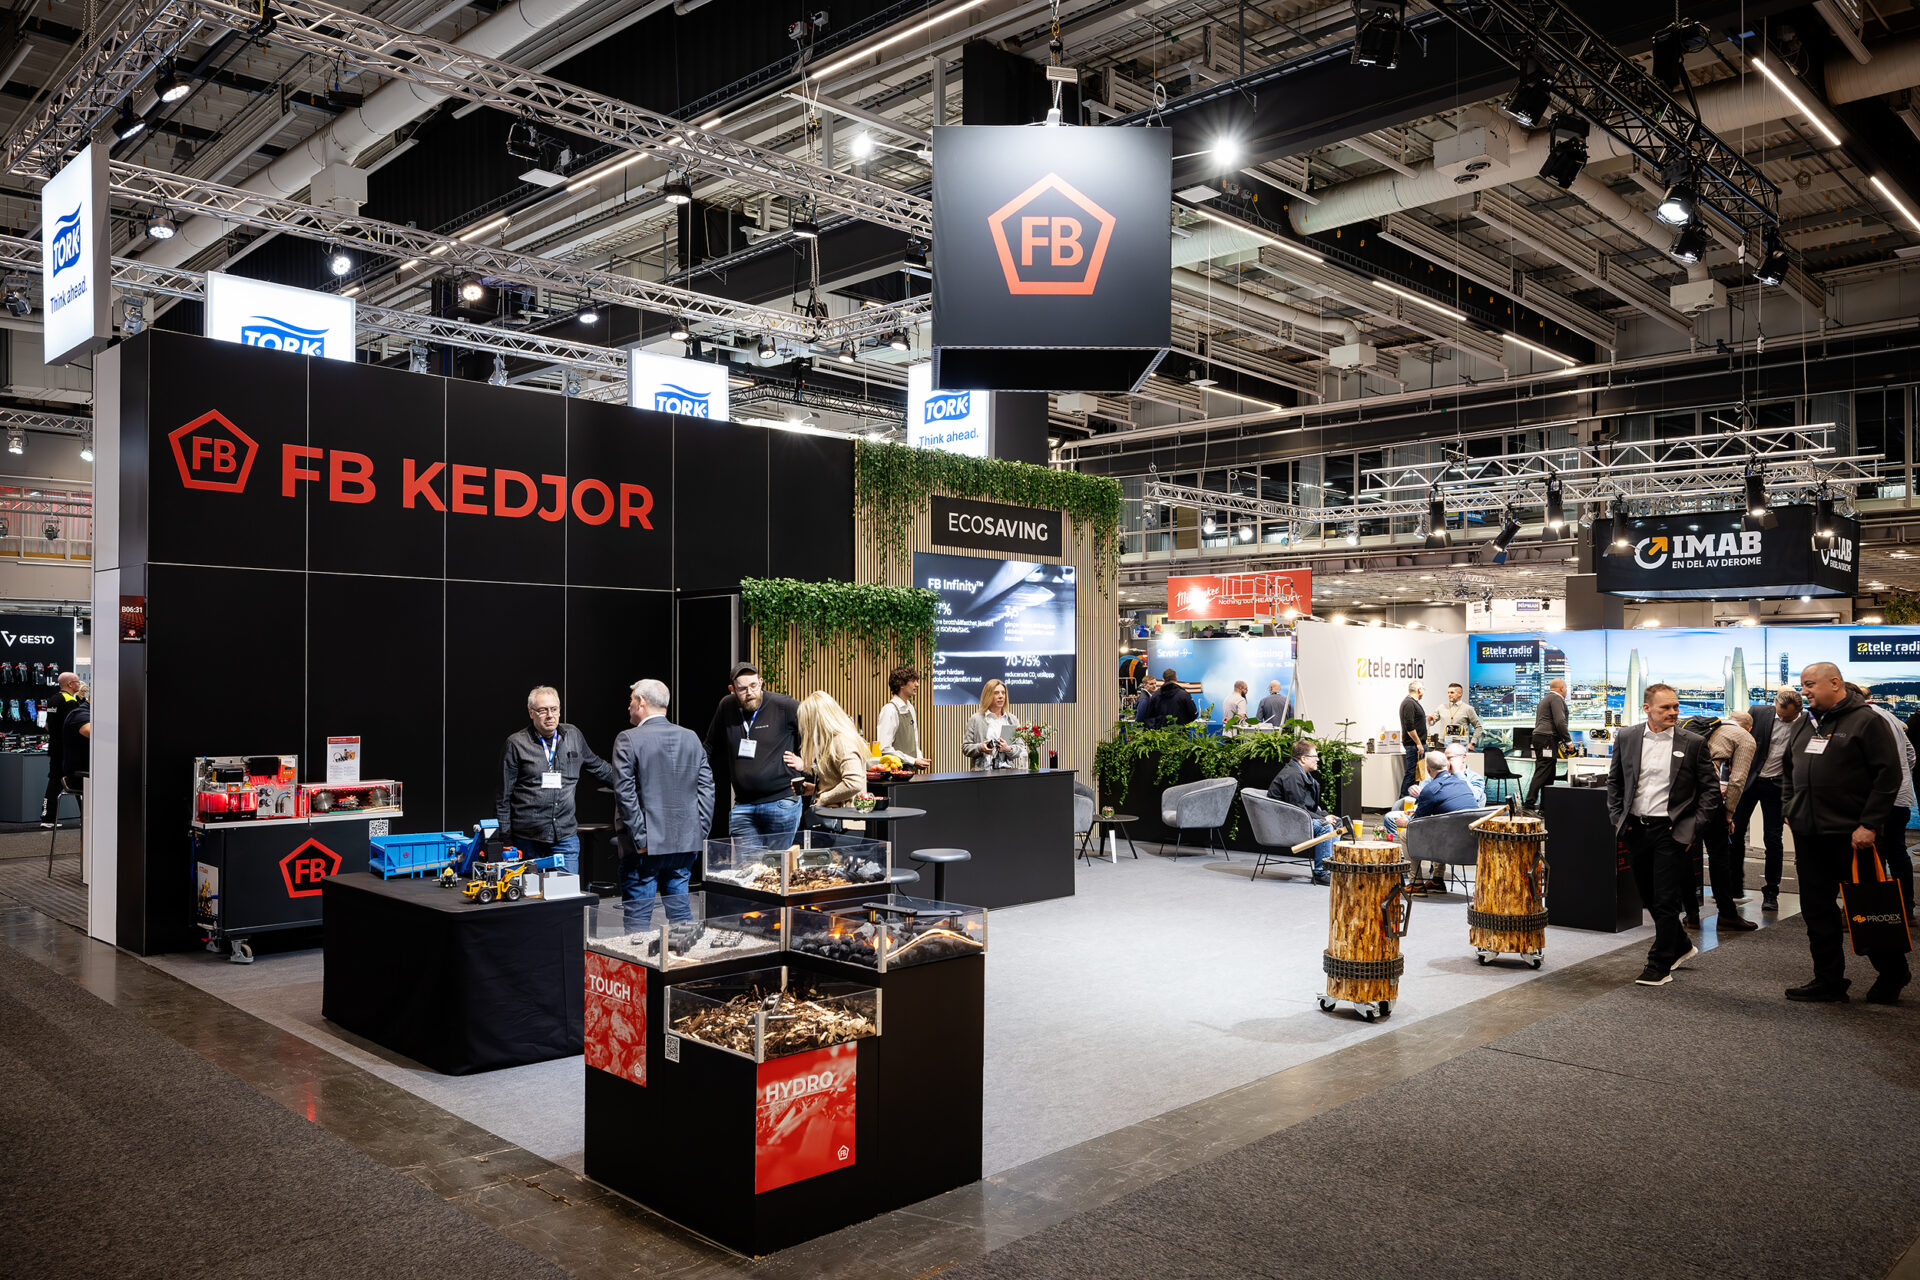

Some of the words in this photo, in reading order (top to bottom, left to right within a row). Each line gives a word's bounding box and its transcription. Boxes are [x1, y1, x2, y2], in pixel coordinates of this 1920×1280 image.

[53, 225, 80, 270] TORK
[1021, 216, 1084, 266] FB
[50, 290, 66, 314] Think
[67, 275, 87, 303] ahead.
[244, 330, 322, 356] TORK
[656, 396, 707, 417] TORK
[926, 396, 969, 420] TORK
[919, 433, 944, 446] Think
[946, 427, 979, 443] ahead.
[192, 436, 237, 473] FB
[282, 444, 377, 504] FB
[402, 458, 654, 530] KEDJOR
[948, 512, 1048, 541] ECOSAVING
[1672, 531, 1762, 559] IMAB
[1672, 561, 1684, 569] EN
[1686, 560, 1705, 568] DEL
[1706, 559, 1719, 567] AV
[1721, 556, 1762, 567] DEROME
[928, 578, 942, 590] FB
[19, 635, 55, 644] GESTO
[1490, 646, 1507, 655] tele
[1508, 645, 1533, 655] radio
[1868, 641, 1892, 652] tele
[1895, 641, 1920, 651] radi
[1004, 654, 1041, 667] 70-75%
[1368, 656, 1391, 678] tele
[1394, 657, 1424, 679] radio
[295, 858, 327, 884] FB
[1867, 913, 1902, 923] PRODEX
[589, 974, 631, 1002] TOUGH
[765, 1070, 834, 1103] HYDRO
